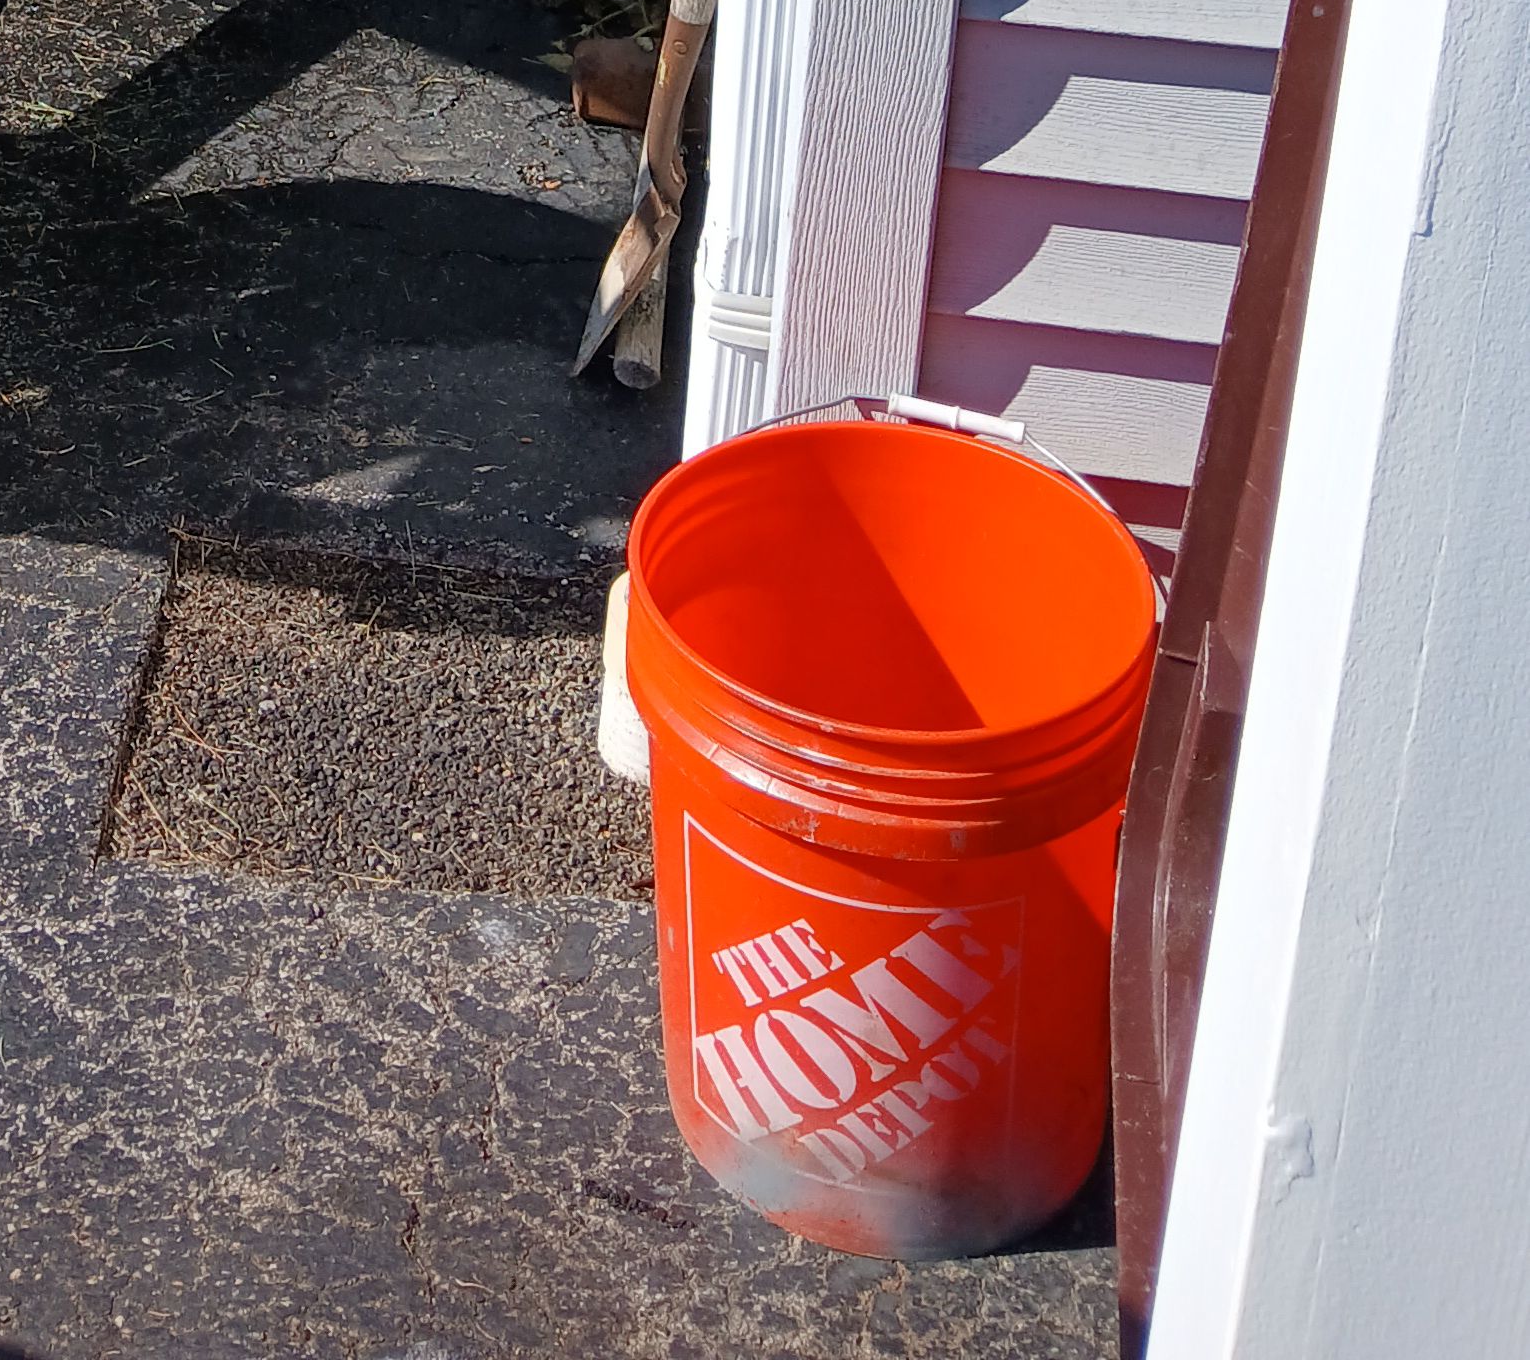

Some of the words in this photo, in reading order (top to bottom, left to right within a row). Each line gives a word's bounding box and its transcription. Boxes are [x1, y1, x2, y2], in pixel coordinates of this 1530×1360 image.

[695, 908, 1021, 1142] HOME
[712, 918, 846, 1008] THE
[798, 1015, 1015, 1181] DEPOT
